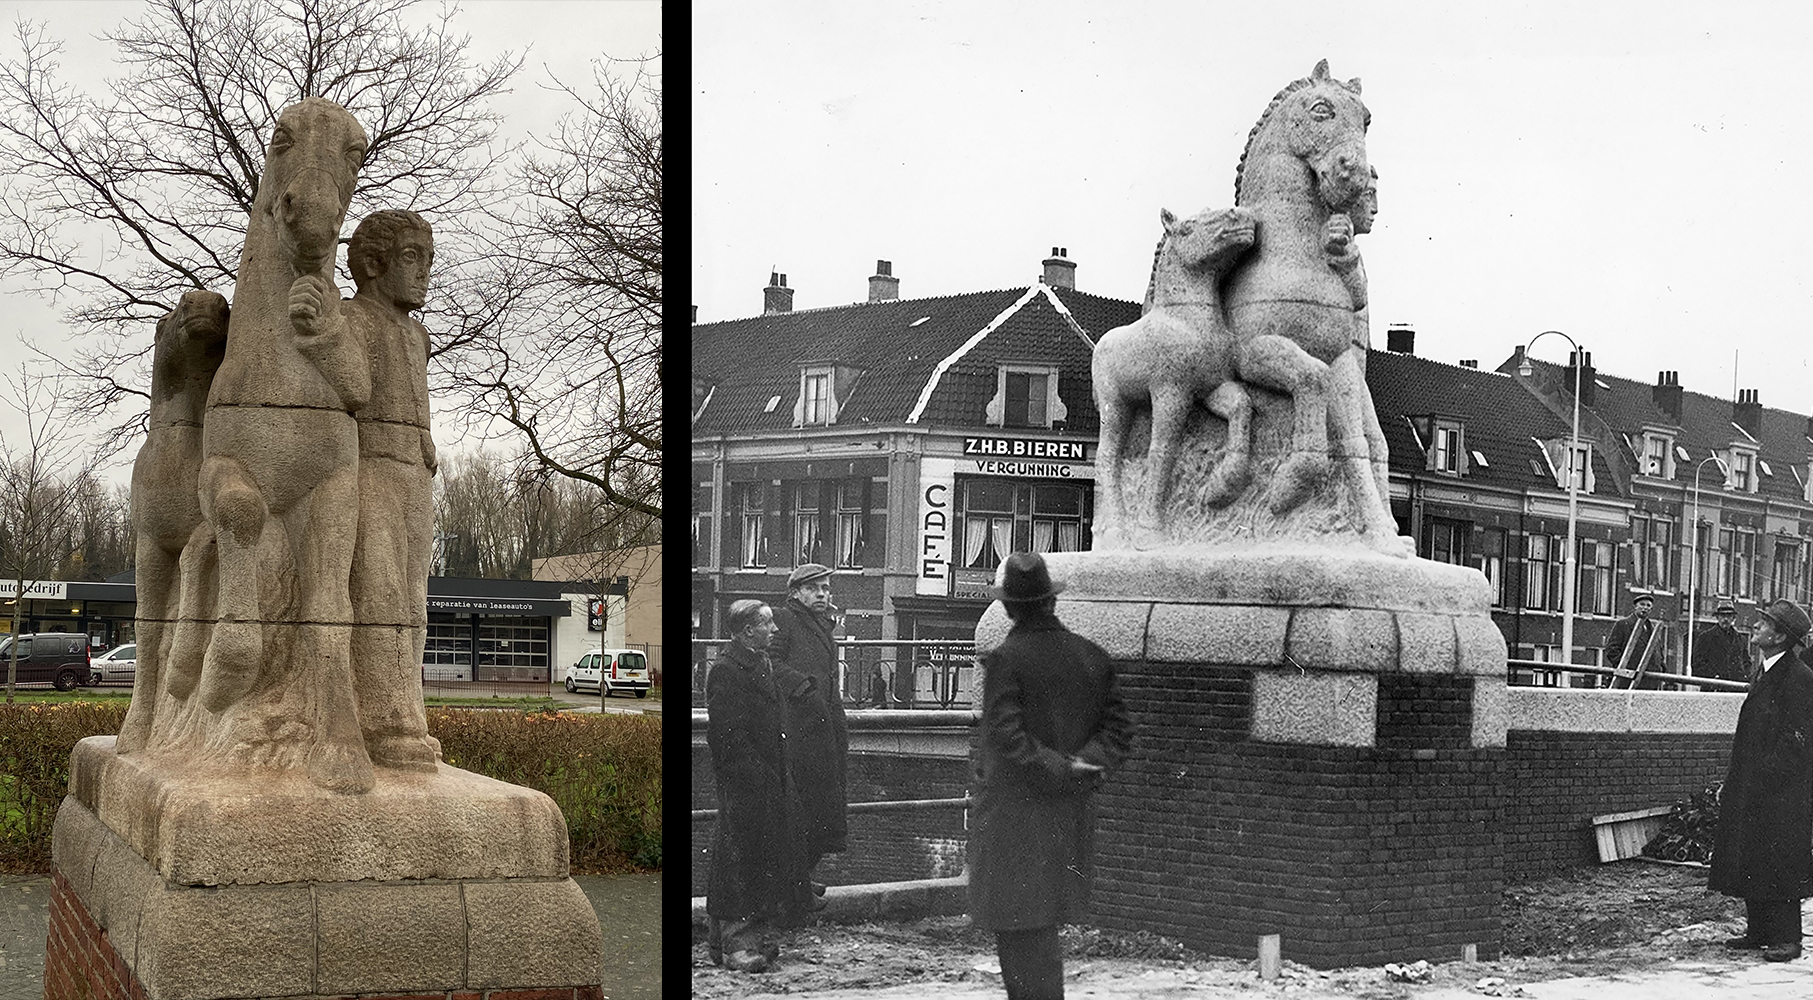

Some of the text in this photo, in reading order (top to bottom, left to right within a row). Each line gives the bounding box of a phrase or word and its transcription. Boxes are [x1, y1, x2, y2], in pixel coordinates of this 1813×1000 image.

[1013, 440, 1083, 458] BIEREN
[975, 460, 1075, 478] VERGUNNING.
[922, 484, 947, 579] CAFÉ
[489, 602, 533, 610] leaseauto's
